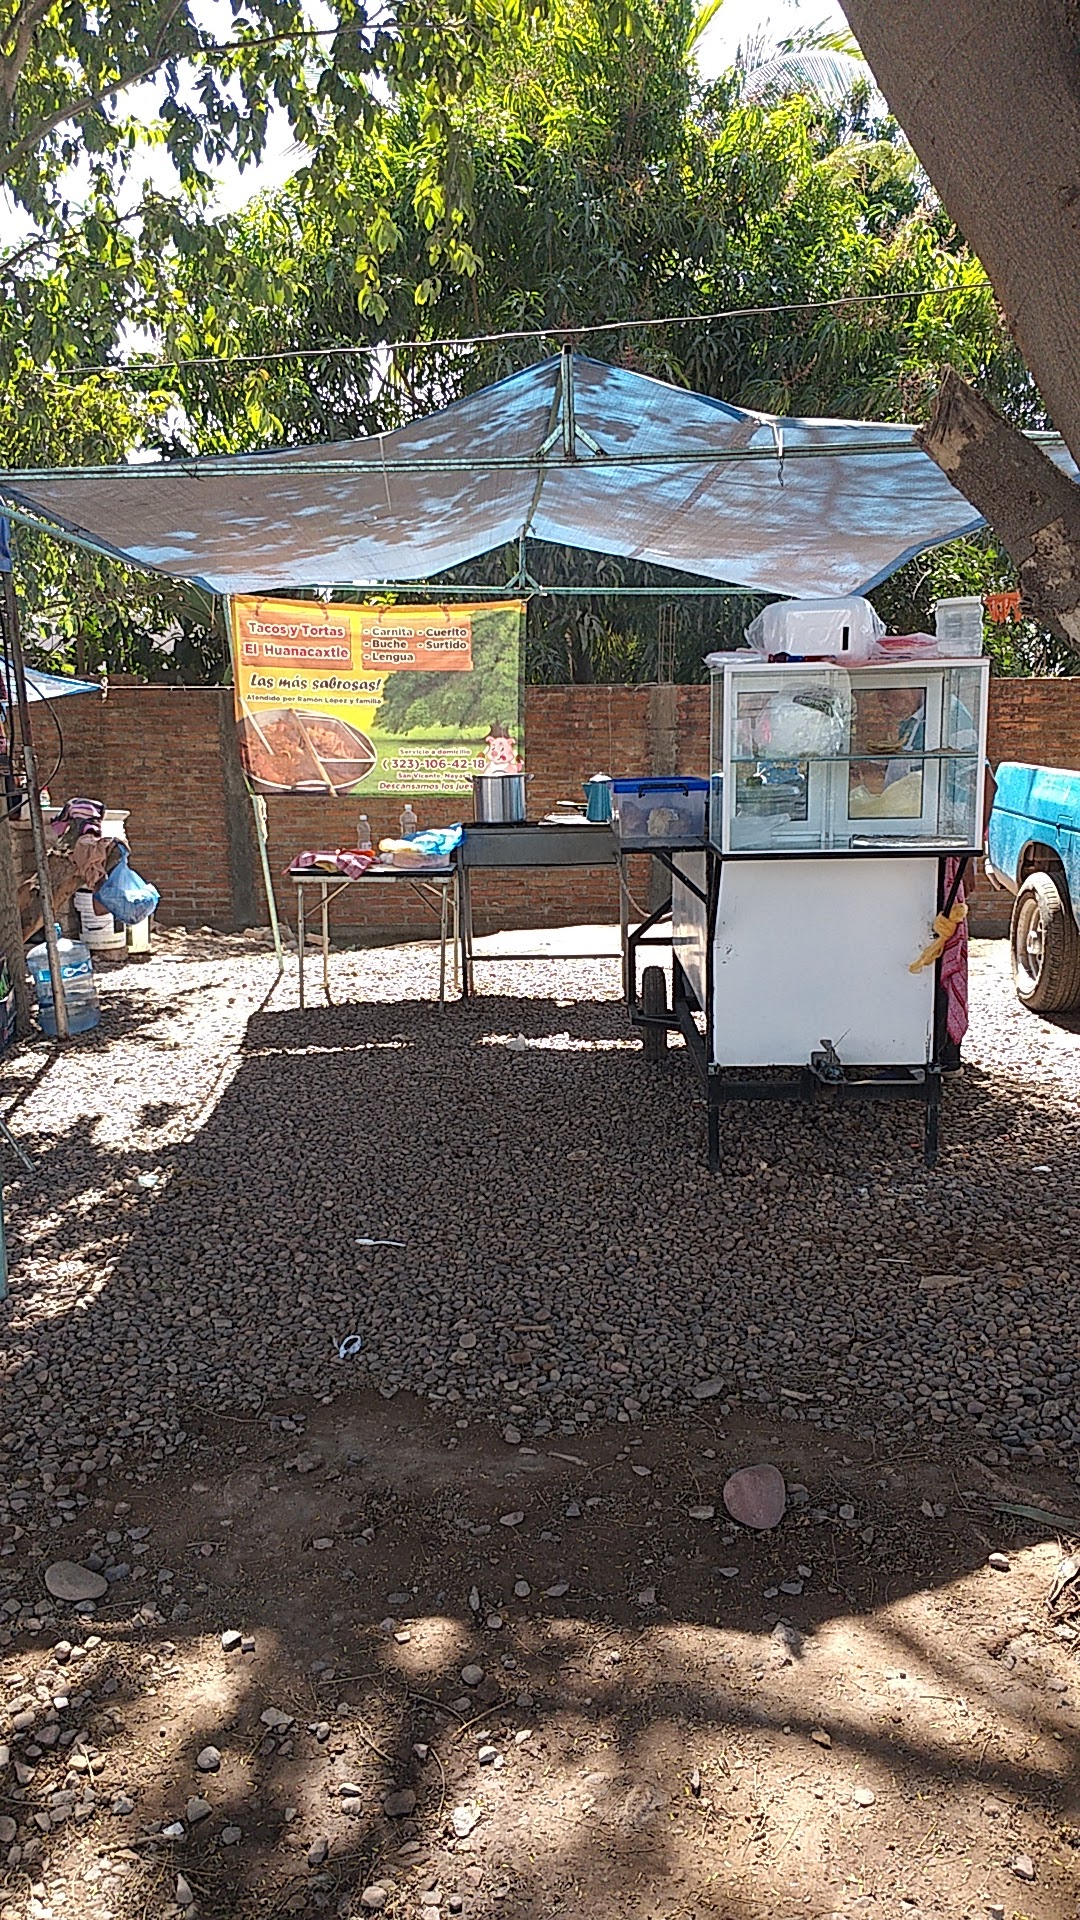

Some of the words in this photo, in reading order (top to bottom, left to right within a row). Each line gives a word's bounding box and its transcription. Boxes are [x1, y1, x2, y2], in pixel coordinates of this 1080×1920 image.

[249, 623, 286, 634] Tacos
[290, 626, 297, 636] y
[302, 625, 344, 636] Tortas
[372, 628, 413, 636] Carnita
[426, 628, 467, 637] Cuerito
[372, 640, 407, 648] Buche
[426, 641, 467, 649] Surtido
[245, 643, 257, 654] El
[264, 644, 349, 657] Huanacaxtle
[372, 652, 414, 662] Lengua
[250, 674, 274, 688] Las
[279, 675, 308, 689] más
[312, 676, 382, 692] sabrosas!
[379, 782, 439, 790] Descansamos
[441, 782, 454, 790] los
